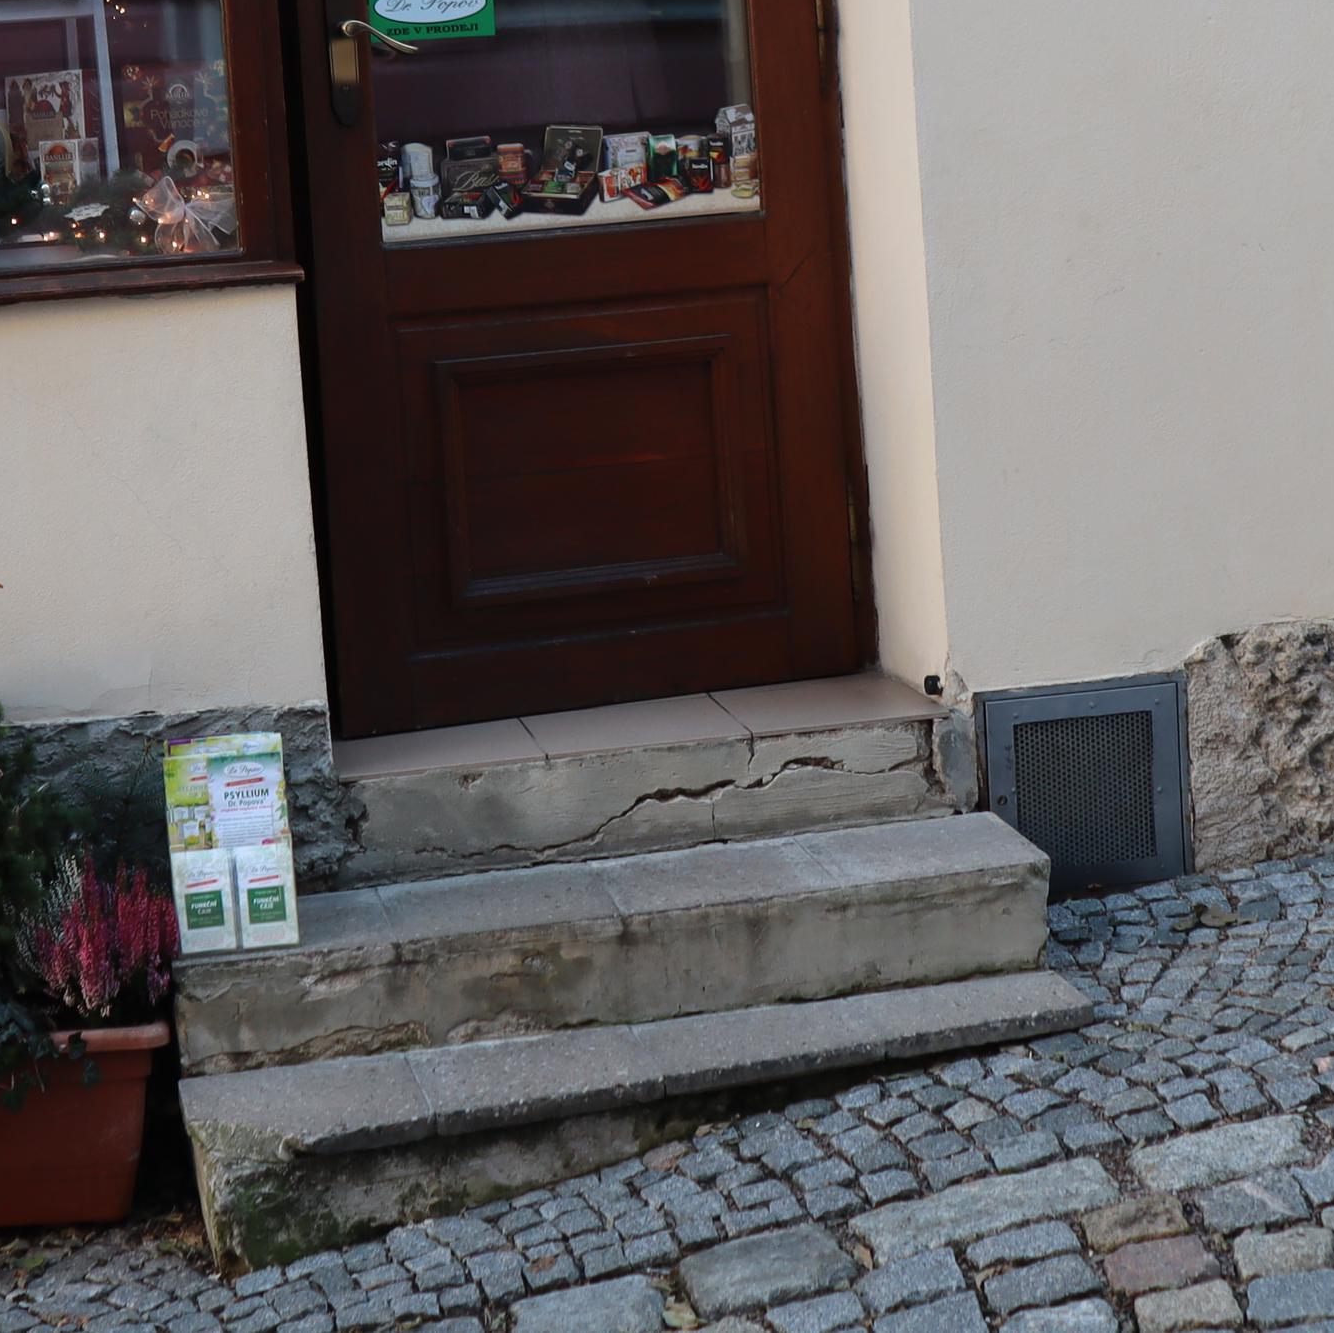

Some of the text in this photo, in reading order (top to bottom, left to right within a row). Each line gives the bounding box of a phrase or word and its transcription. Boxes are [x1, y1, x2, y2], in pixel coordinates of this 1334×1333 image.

[386, 23, 479, 37] ZDE V PRODEJI
[223, 788, 270, 801] PSYLLIUM
